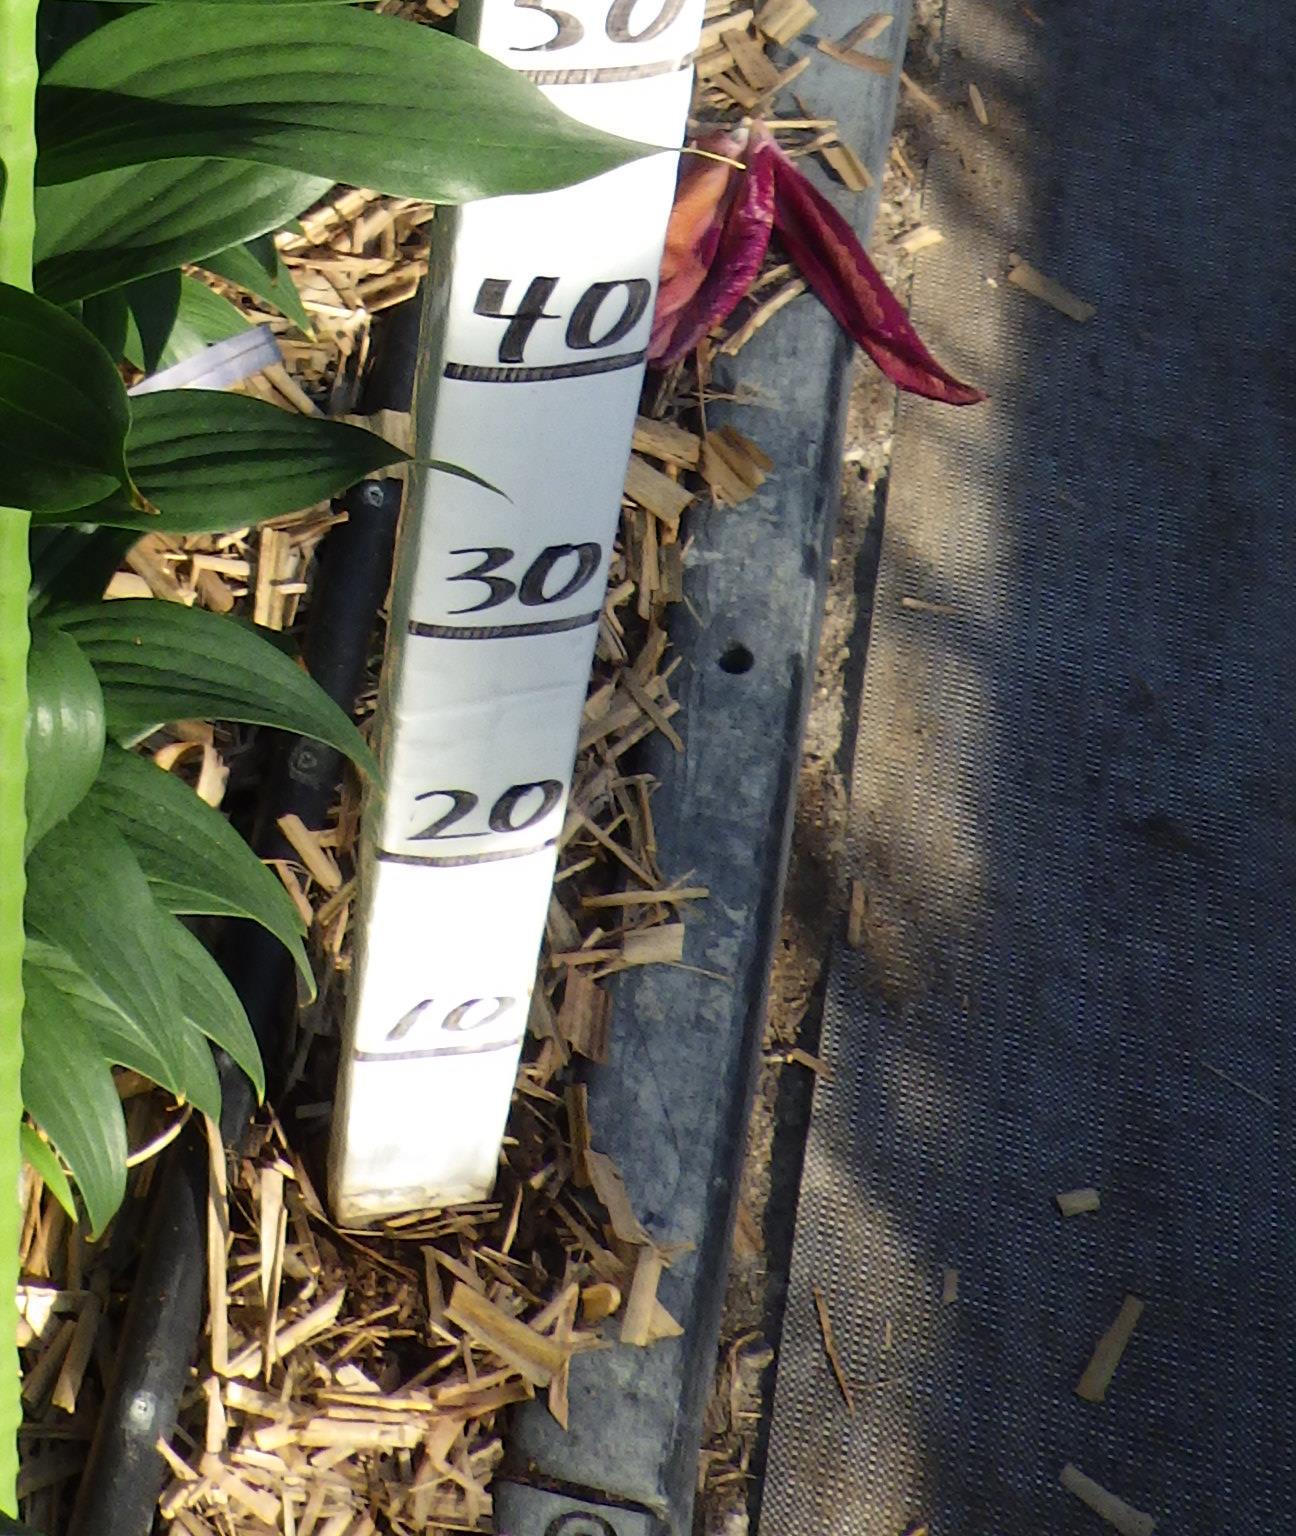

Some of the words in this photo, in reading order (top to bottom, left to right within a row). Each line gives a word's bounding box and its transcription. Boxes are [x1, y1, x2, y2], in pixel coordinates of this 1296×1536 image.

[472, 274, 652, 364] 40
[444, 542, 603, 618] 30
[406, 778, 566, 842] 20
[384, 994, 517, 1043] 10
